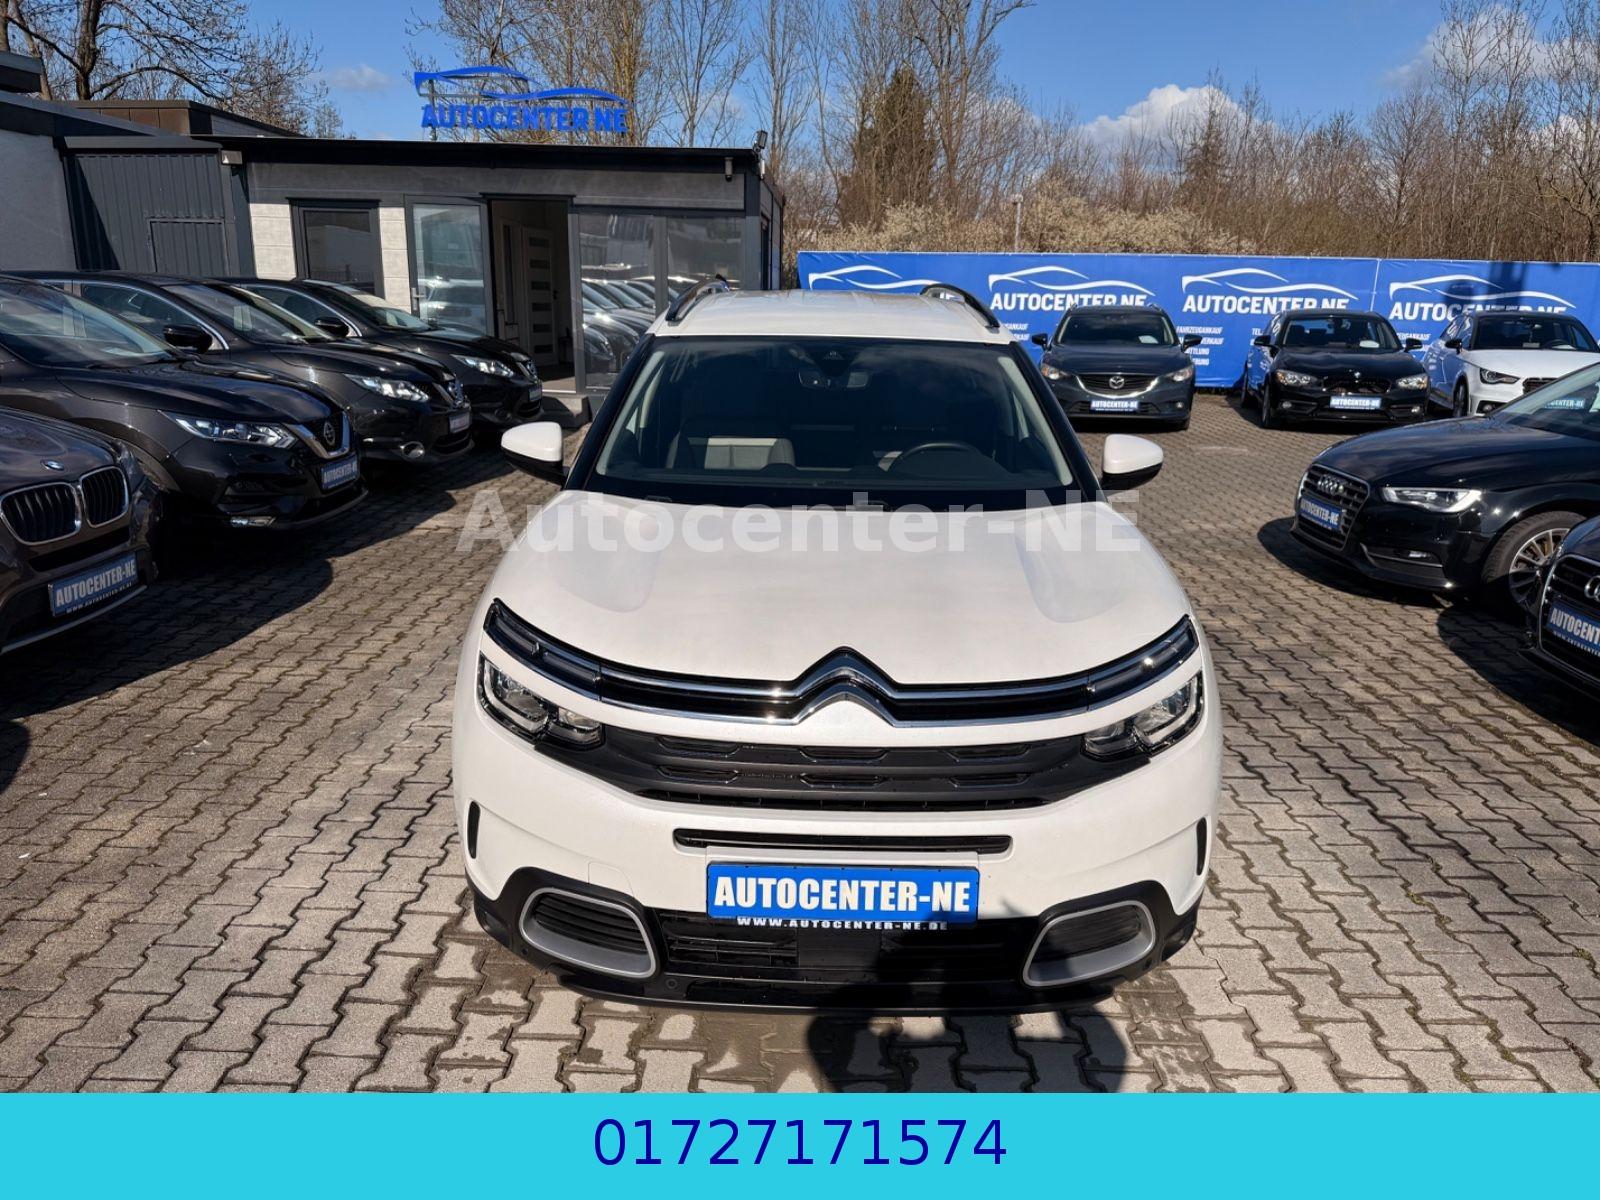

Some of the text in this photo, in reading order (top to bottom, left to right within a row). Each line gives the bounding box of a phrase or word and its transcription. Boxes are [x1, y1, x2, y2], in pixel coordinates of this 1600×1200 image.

[421, 103, 628, 134] AUTOCENTER NE
[990, 293, 1117, 311] AUTOCENTER
[1182, 294, 1317, 314] AUTOCENTER
[56, 559, 136, 607] AUTOCENTER-NE
[1550, 607, 1600, 645] AUTOCENT
[714, 876, 971, 912] AUTOCENTER-NE
[736, 915, 948, 930] WWW.AUTOCENTER-NE.DE
